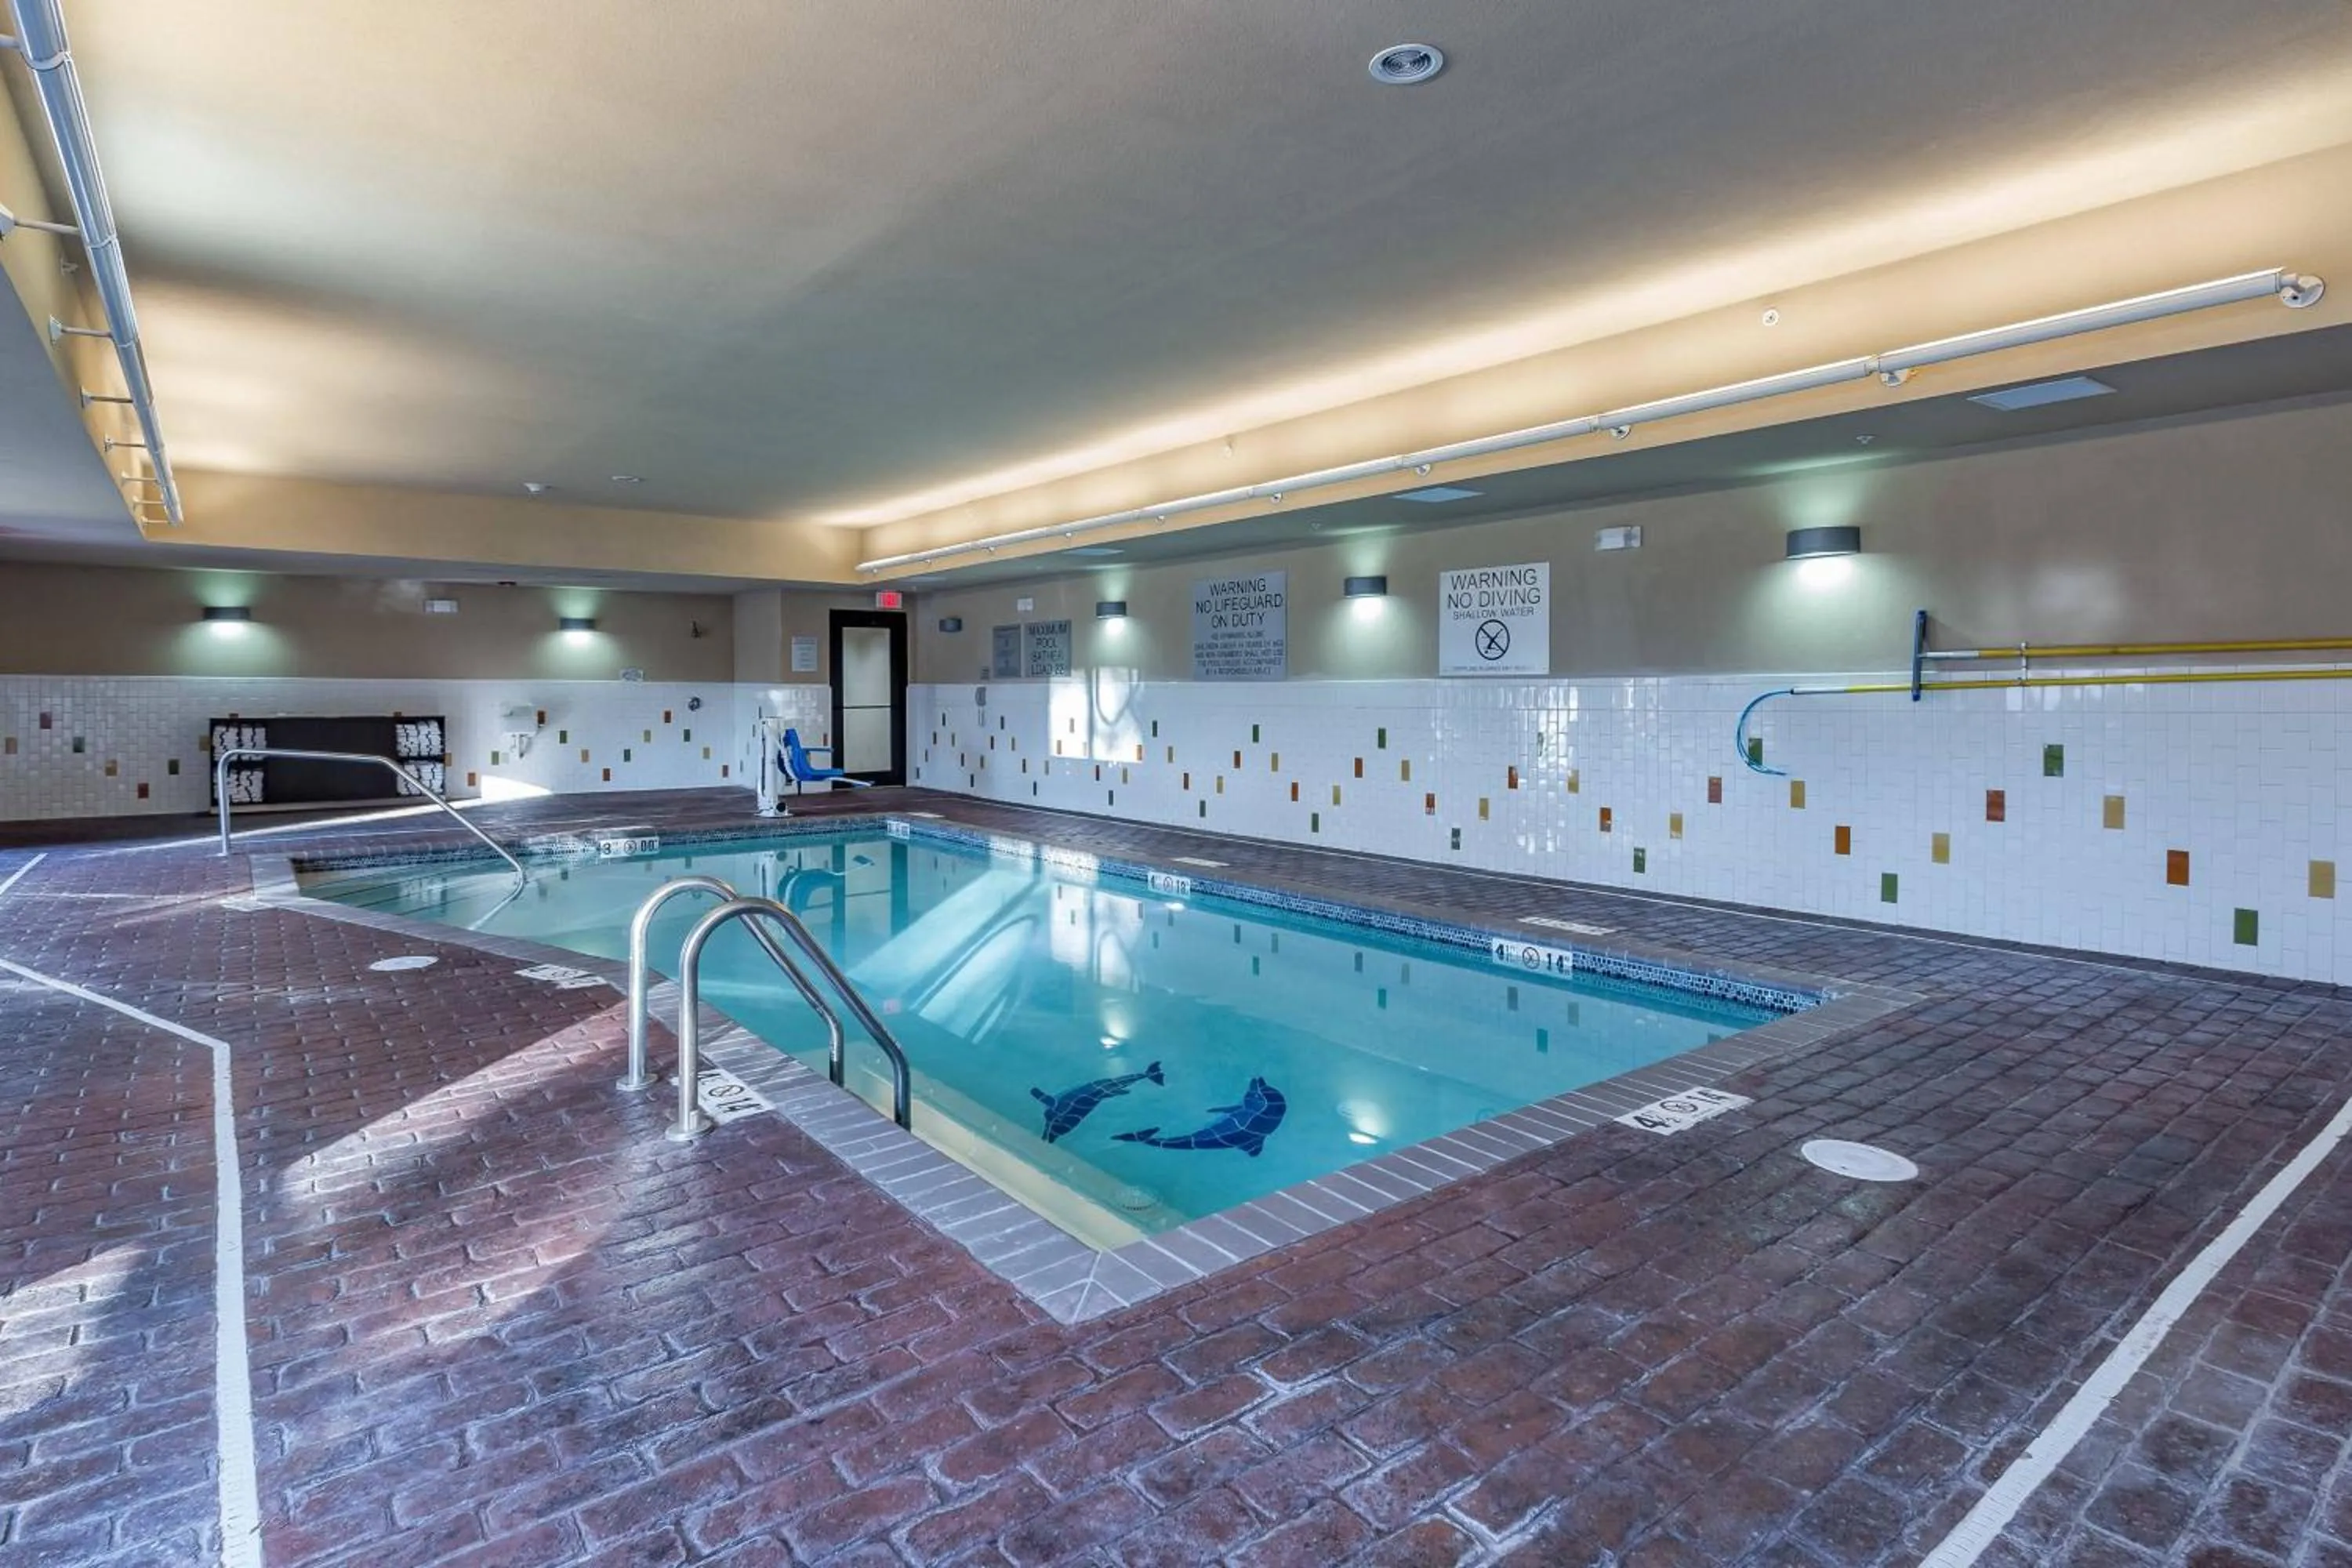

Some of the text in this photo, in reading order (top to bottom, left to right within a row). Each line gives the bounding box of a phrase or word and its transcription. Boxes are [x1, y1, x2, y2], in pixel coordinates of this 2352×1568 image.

[1210, 577, 1266, 596] WARNING
[1451, 568, 1537, 590] WARNING
[1196, 593, 1283, 614] NO LIFEGUARD
[1447, 587, 1541, 609] NO DIVING
[1211, 612, 1266, 629] ON DUTY
[1453, 607, 1534, 620] SHALLOW WATER
